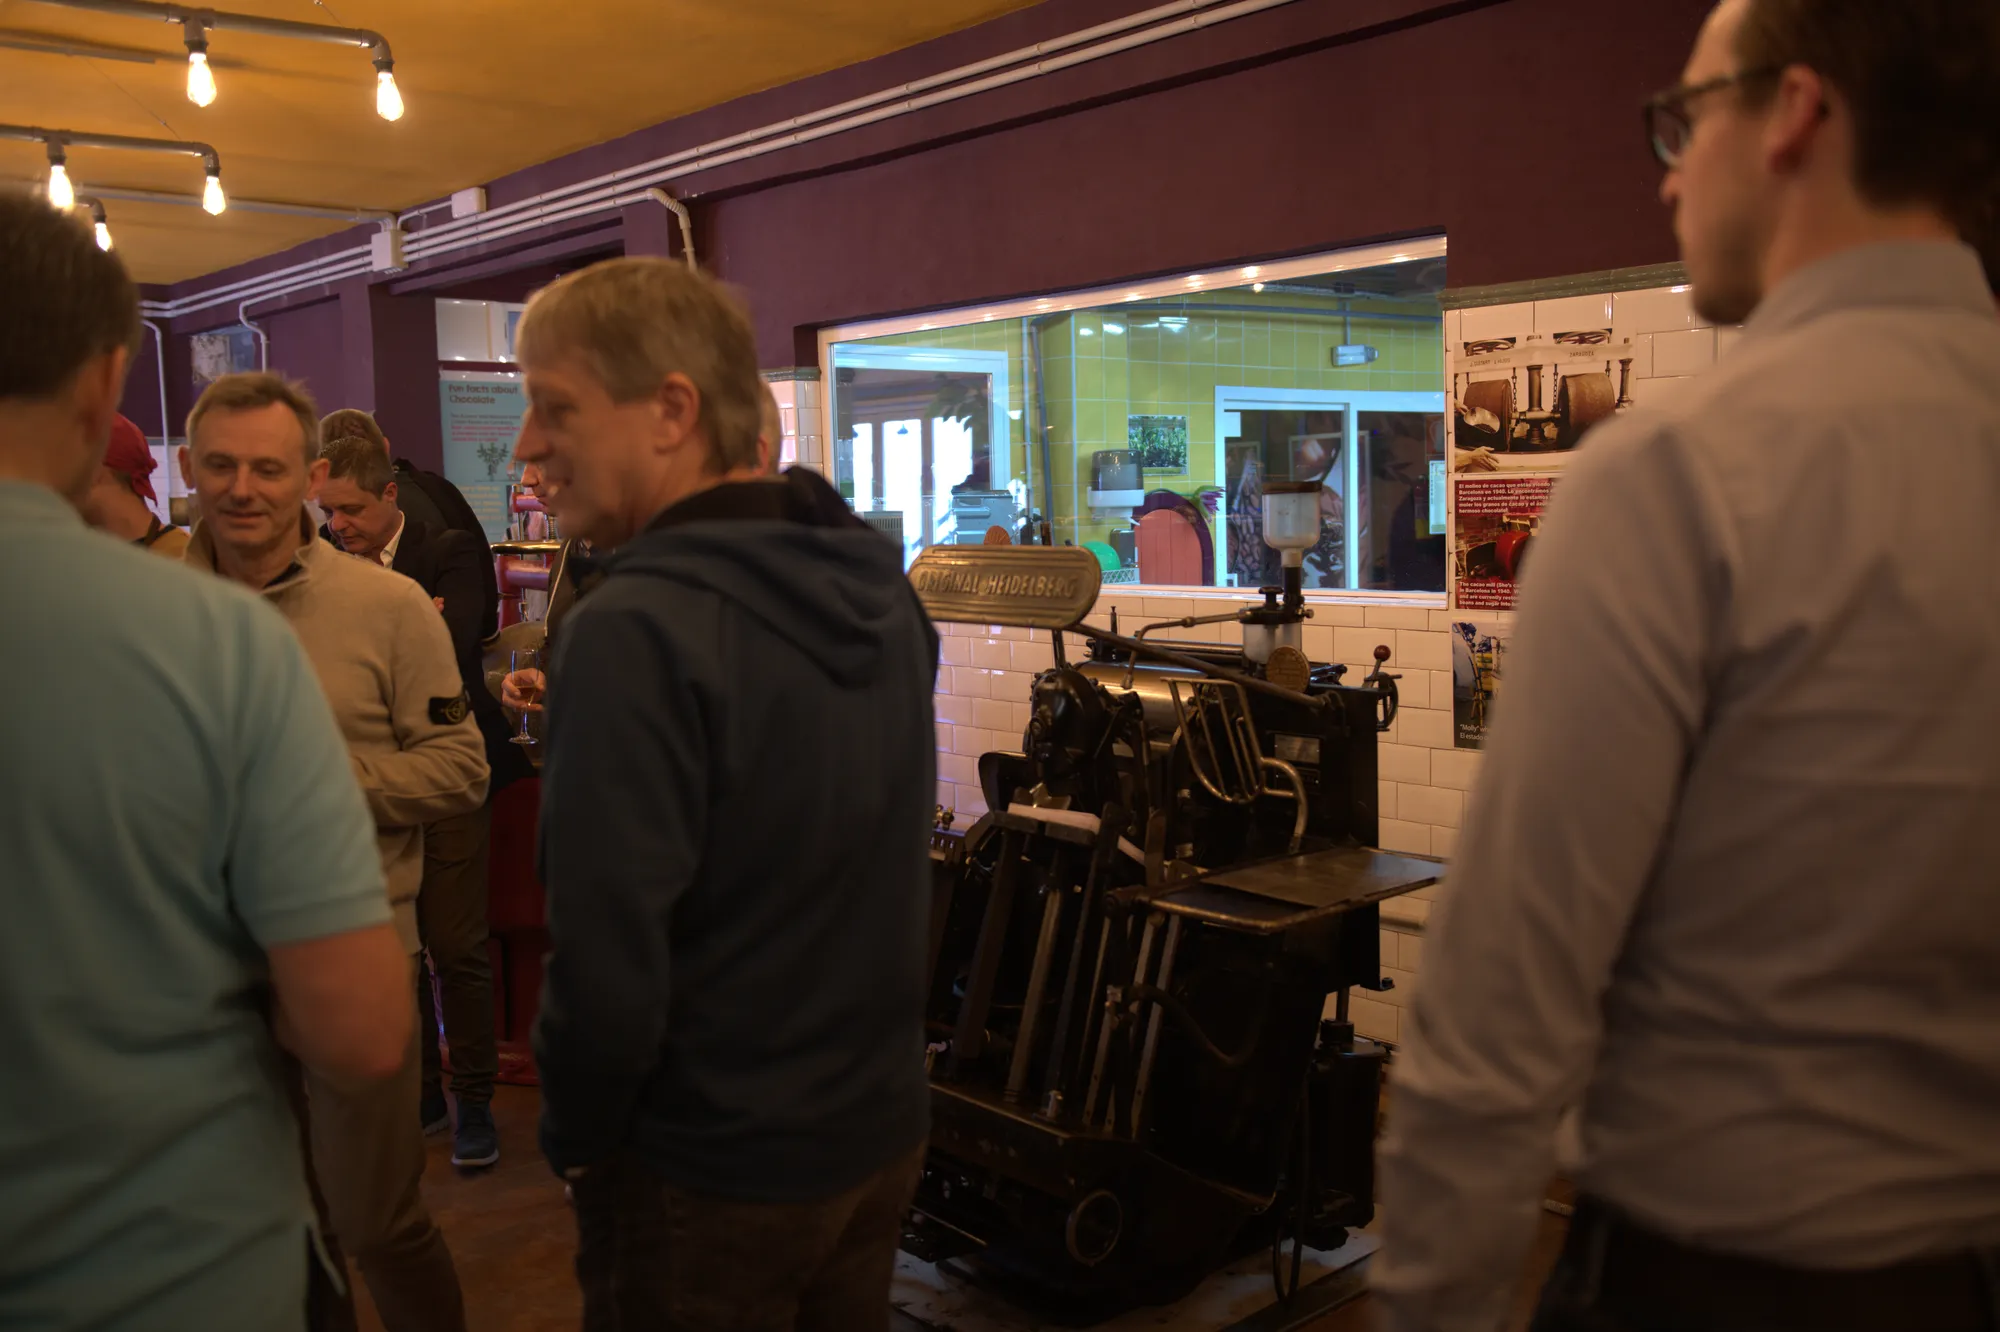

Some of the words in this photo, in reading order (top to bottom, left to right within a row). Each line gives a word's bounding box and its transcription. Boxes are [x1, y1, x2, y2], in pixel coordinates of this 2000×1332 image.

[466, 384, 489, 393] facts
[491, 385, 518, 394] about
[450, 395, 496, 404] Chocolate
[918, 571, 978, 593] ORIGINAL
[988, 574, 1078, 598] HEIDELBERG
